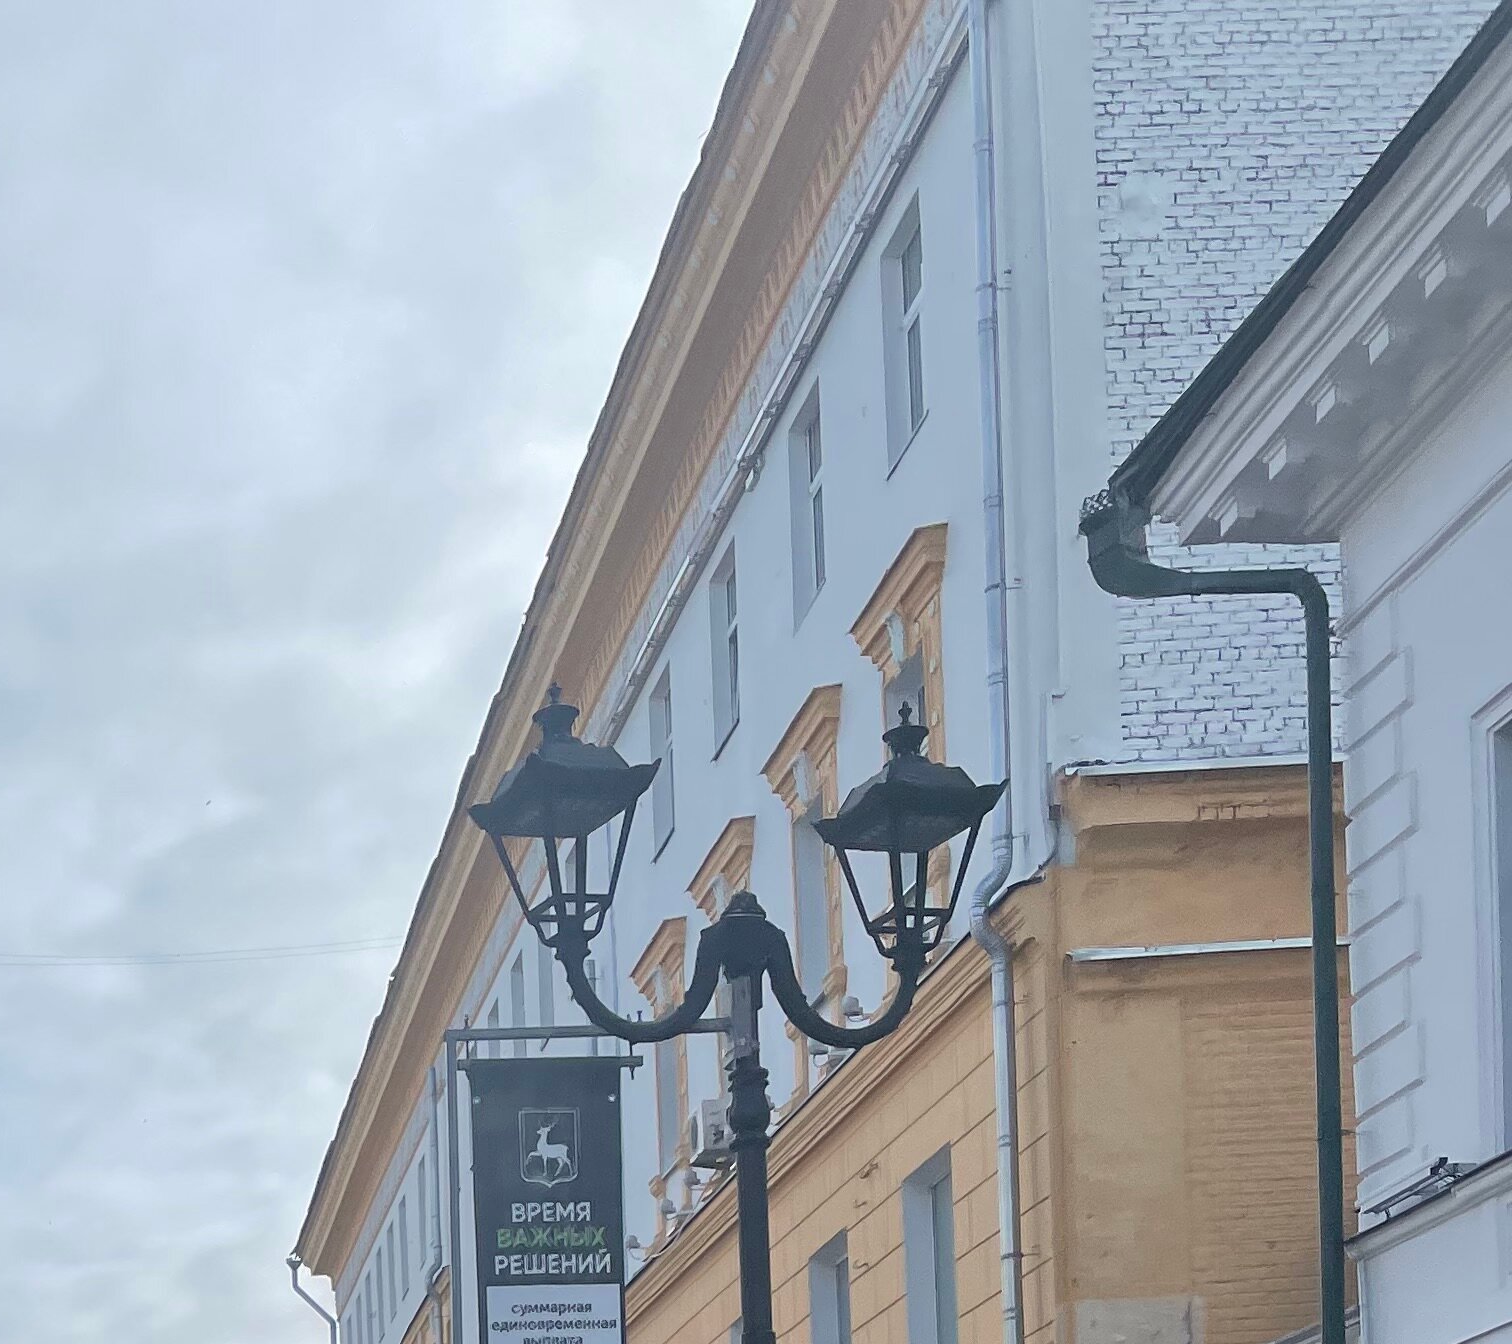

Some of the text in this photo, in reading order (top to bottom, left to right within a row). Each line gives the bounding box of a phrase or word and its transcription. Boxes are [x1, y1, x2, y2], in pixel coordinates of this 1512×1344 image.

[511, 1202, 591, 1222] ВРЕМЯ
[496, 1227, 607, 1248] ВАЖНЫХ
[494, 1249, 611, 1275] РЕШЕНИЙ
[511, 1303, 592, 1316] суммарная
[491, 1318, 617, 1332] единовременная
